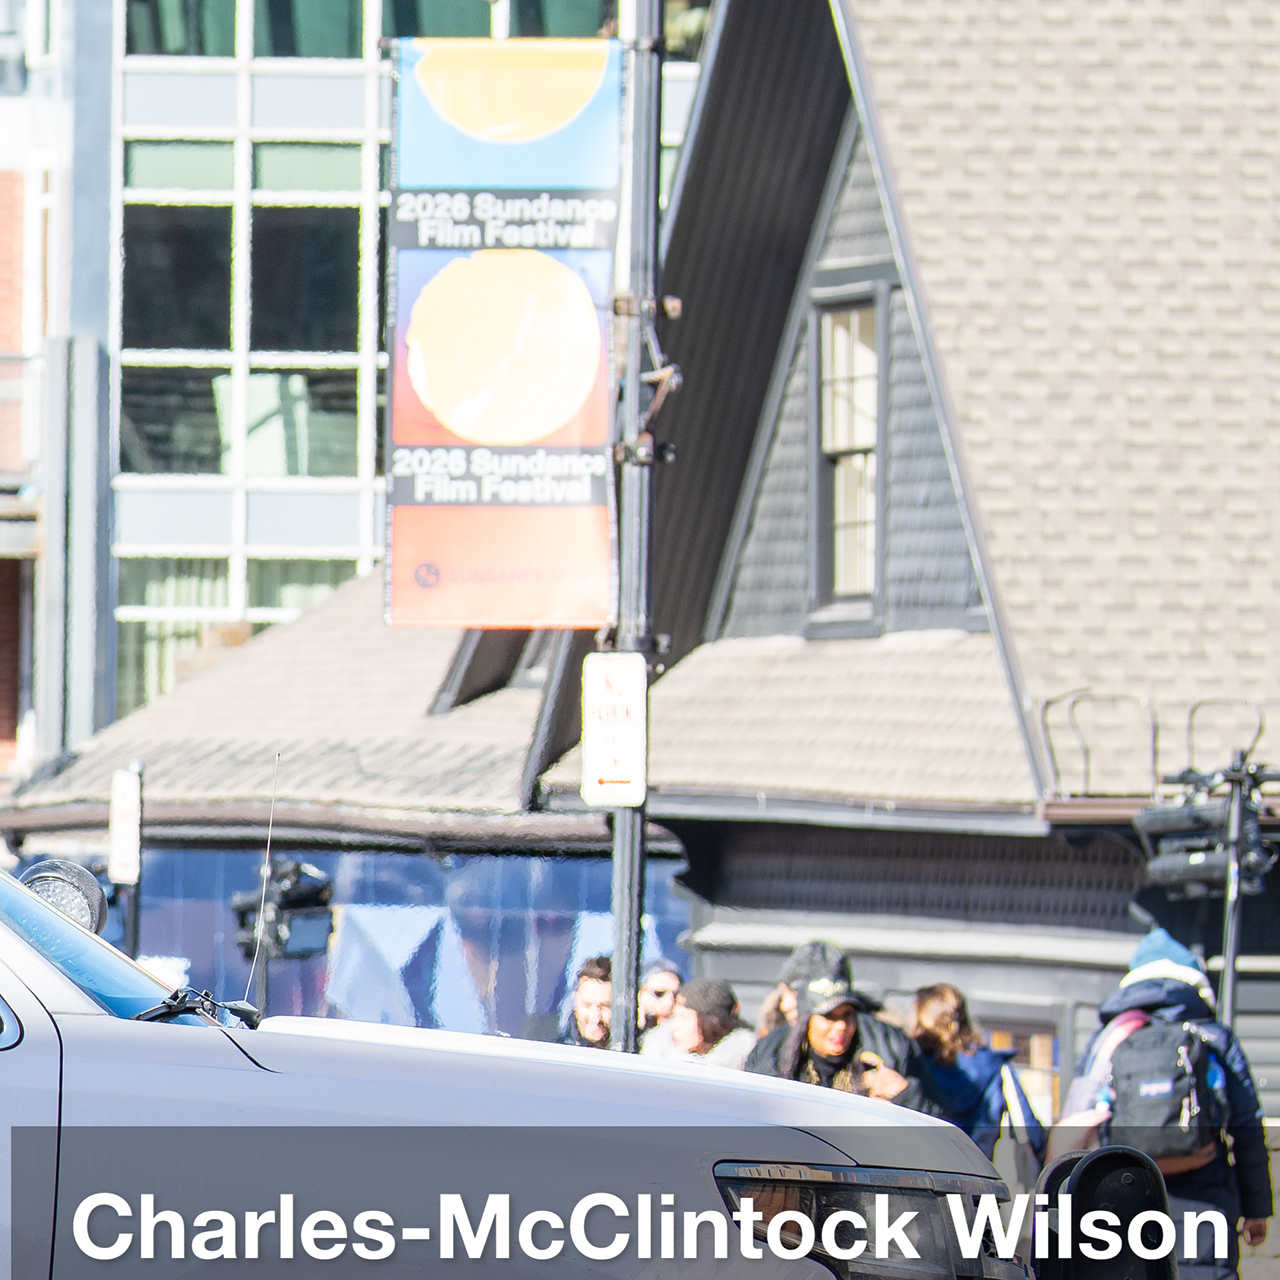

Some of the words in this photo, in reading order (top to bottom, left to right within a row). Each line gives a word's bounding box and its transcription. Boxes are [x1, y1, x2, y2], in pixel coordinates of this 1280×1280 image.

[396, 192, 471, 221] 2026
[473, 192, 617, 221] Sundance
[418, 219, 481, 247] Film
[484, 218, 595, 247] Festival
[392, 447, 467, 476] 2026
[469, 447, 607, 476] Sundance
[414, 474, 478, 503] Film
[481, 474, 591, 503] Festival
